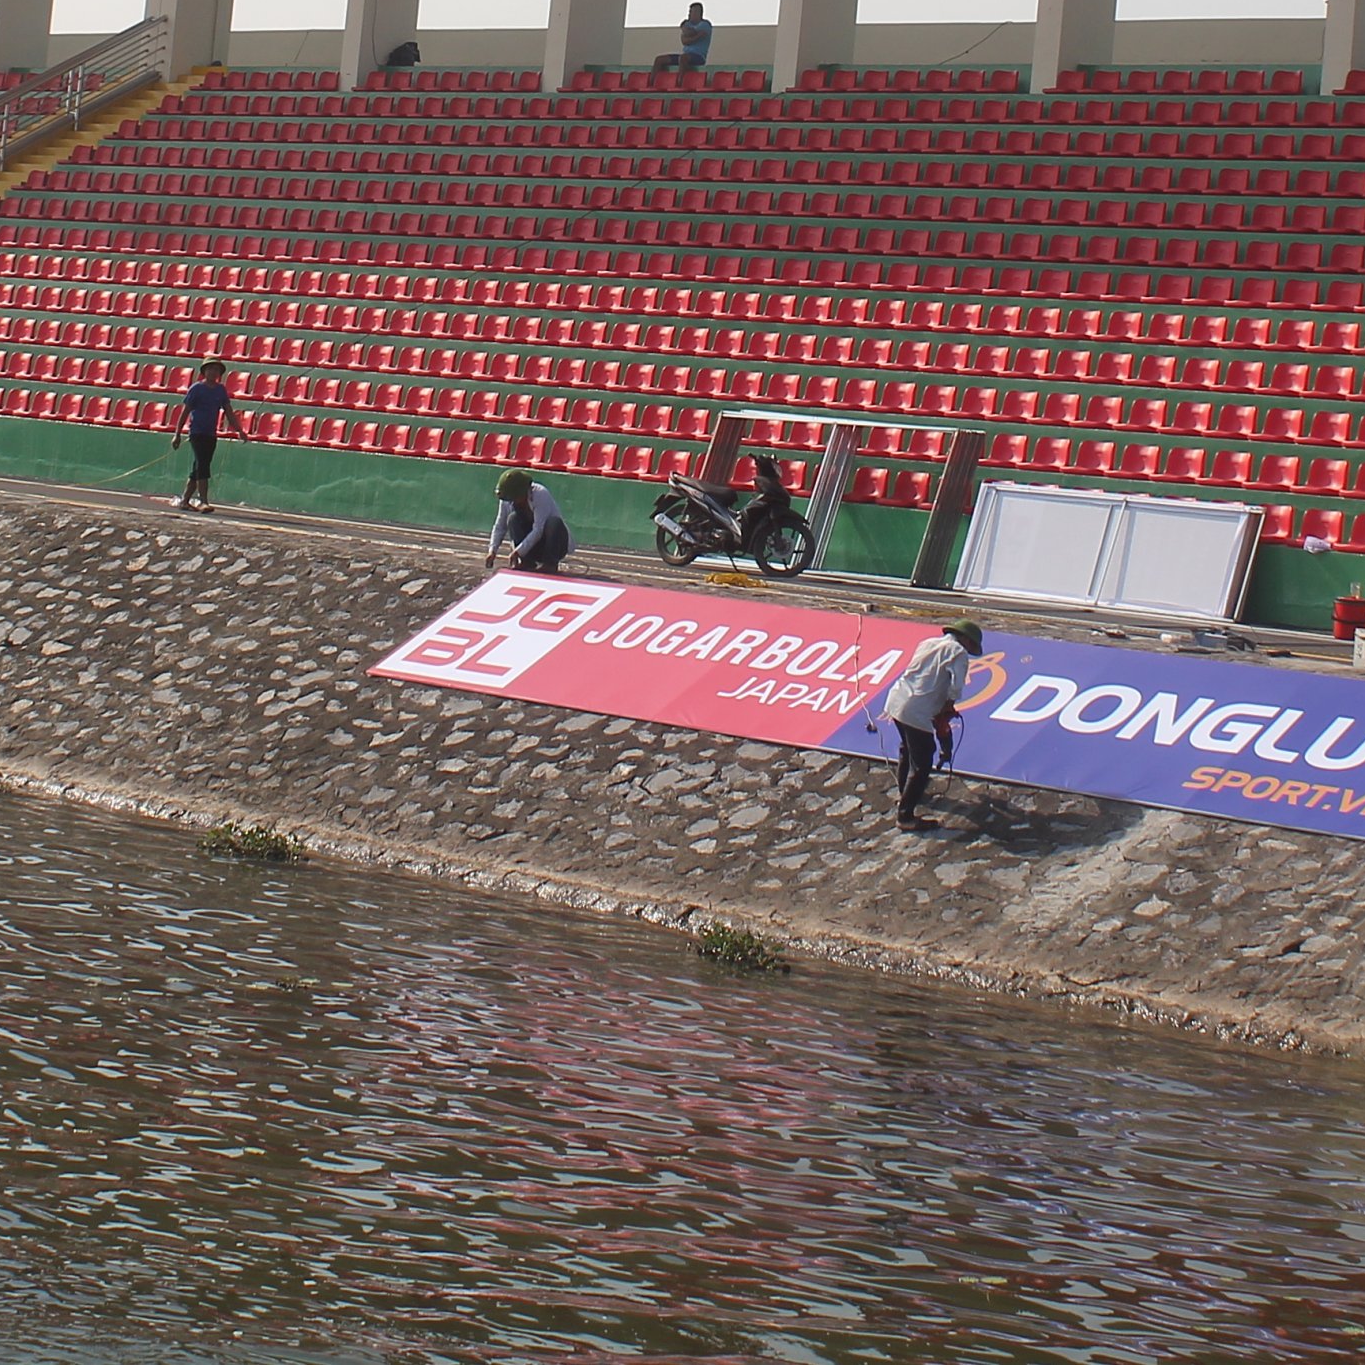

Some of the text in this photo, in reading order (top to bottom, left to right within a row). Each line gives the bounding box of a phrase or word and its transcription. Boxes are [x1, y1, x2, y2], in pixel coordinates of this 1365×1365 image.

[457, 586, 601, 632] JG
[402, 626, 512, 676] BL
[583, 612, 904, 685] JOGARBOLA
[716, 676, 867, 715] JAPAN
